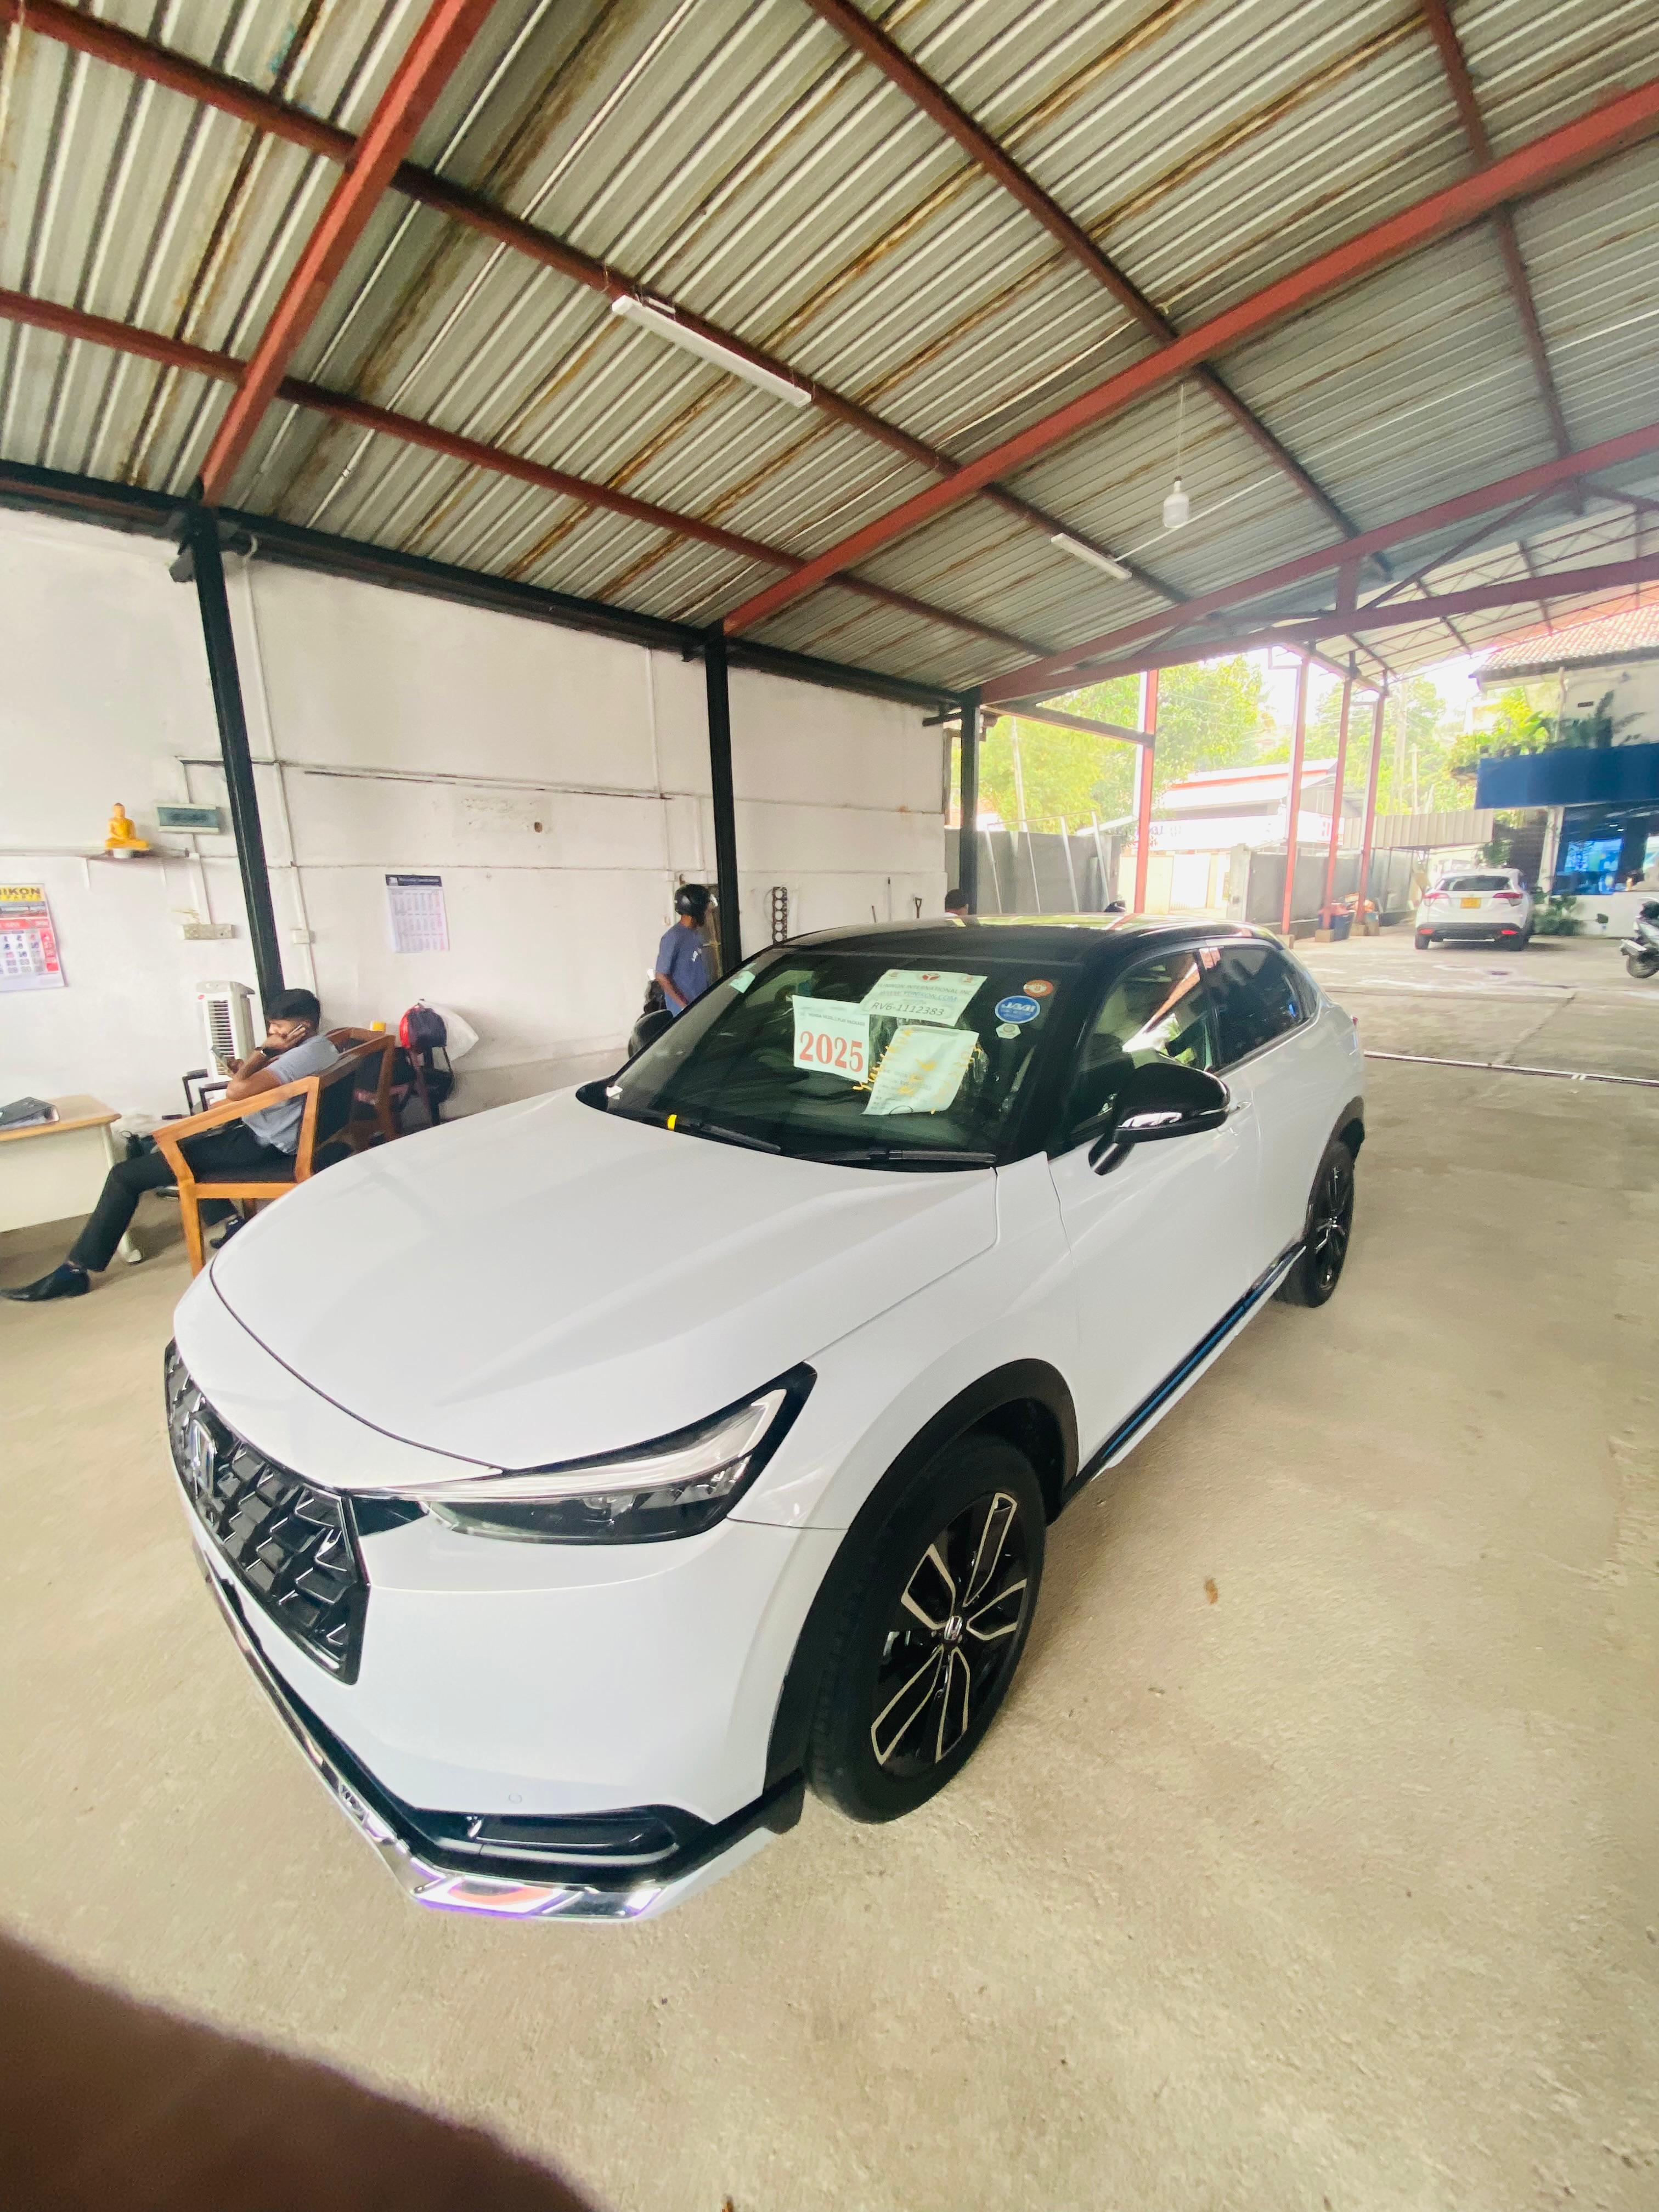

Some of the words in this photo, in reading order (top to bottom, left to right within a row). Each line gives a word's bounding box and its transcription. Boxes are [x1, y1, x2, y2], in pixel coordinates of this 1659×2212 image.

[0, 887, 41, 895] IKON
[906, 984, 958, 994] INTERNATIONAL
[871, 1002, 944, 1015] RV6-1112383
[799, 1031, 863, 1072] 2025
